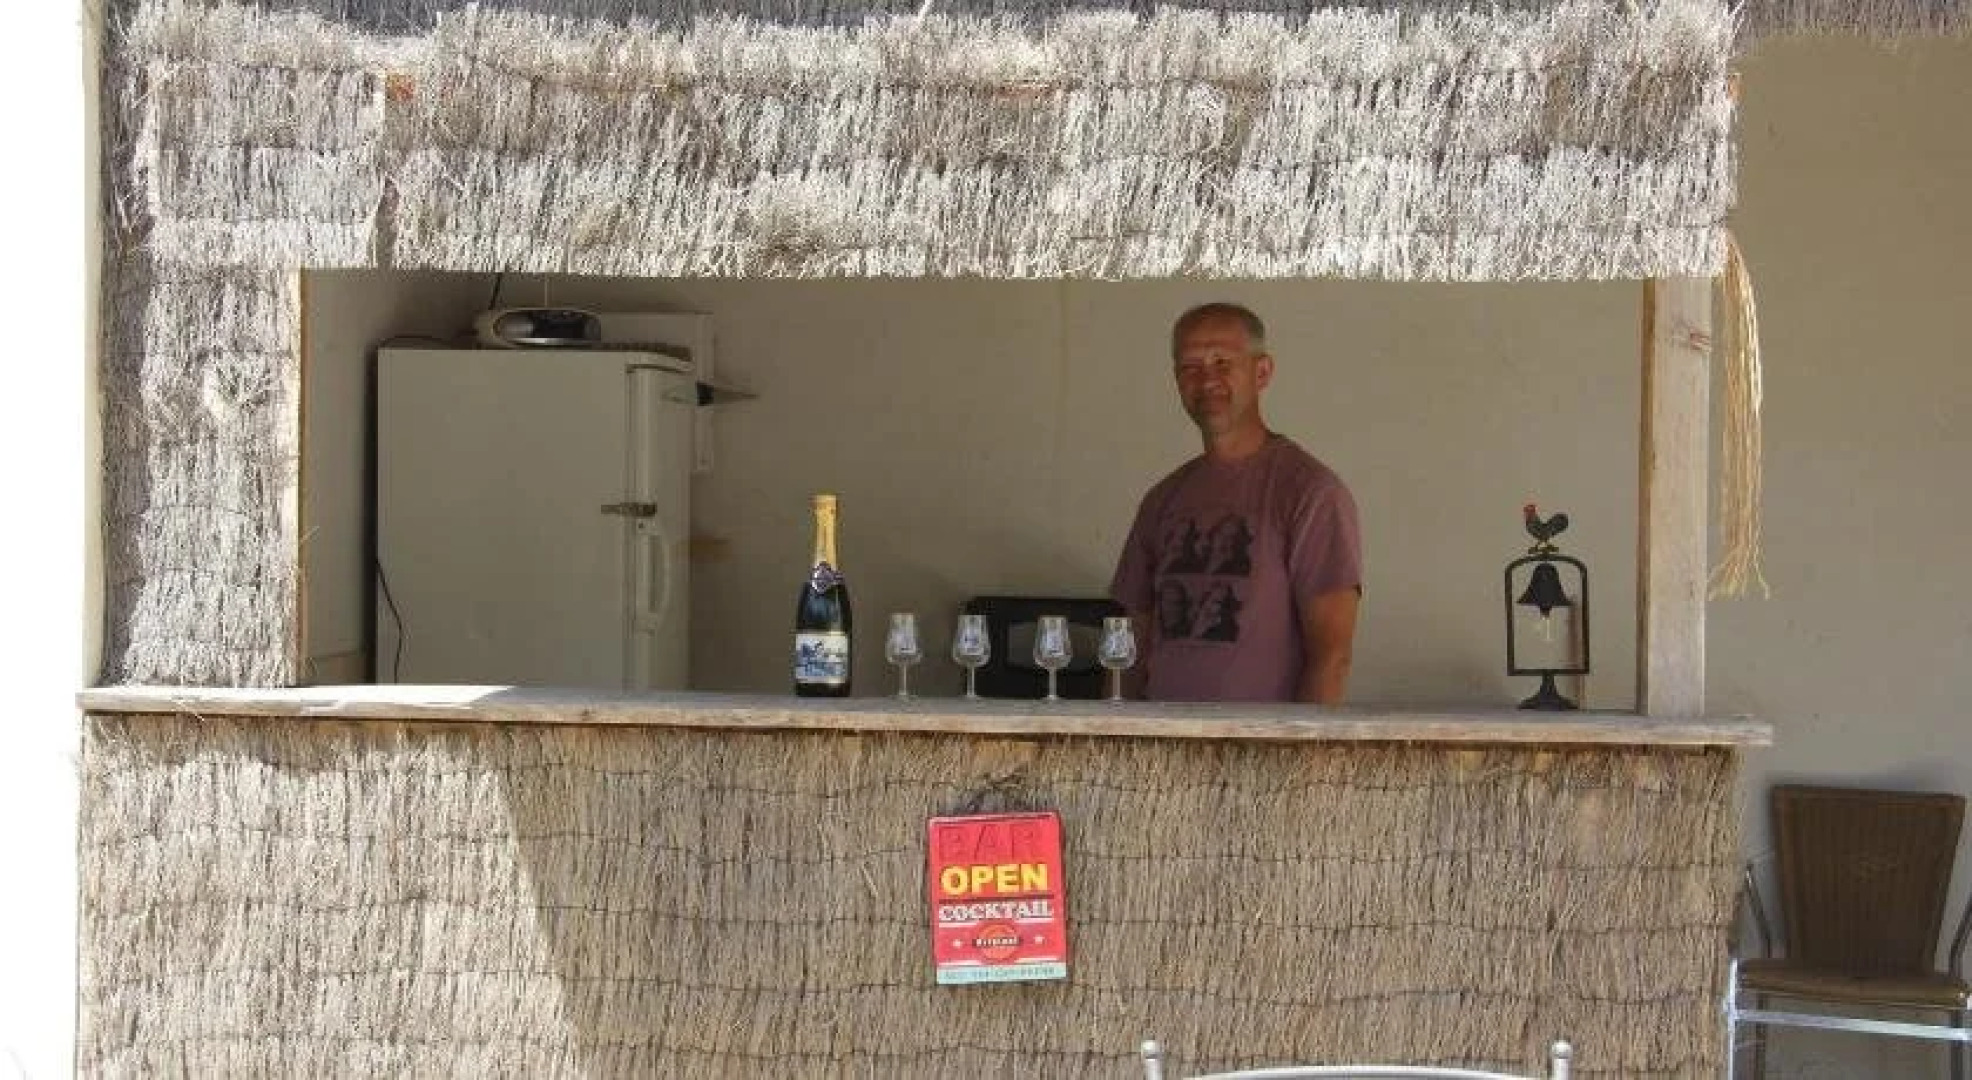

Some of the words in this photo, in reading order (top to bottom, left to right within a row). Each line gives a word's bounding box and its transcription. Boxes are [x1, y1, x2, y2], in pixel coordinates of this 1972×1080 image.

[938, 824, 1041, 861] BAR
[940, 863, 1048, 896] OPEN
[938, 900, 1055, 922] COCKTAIL
